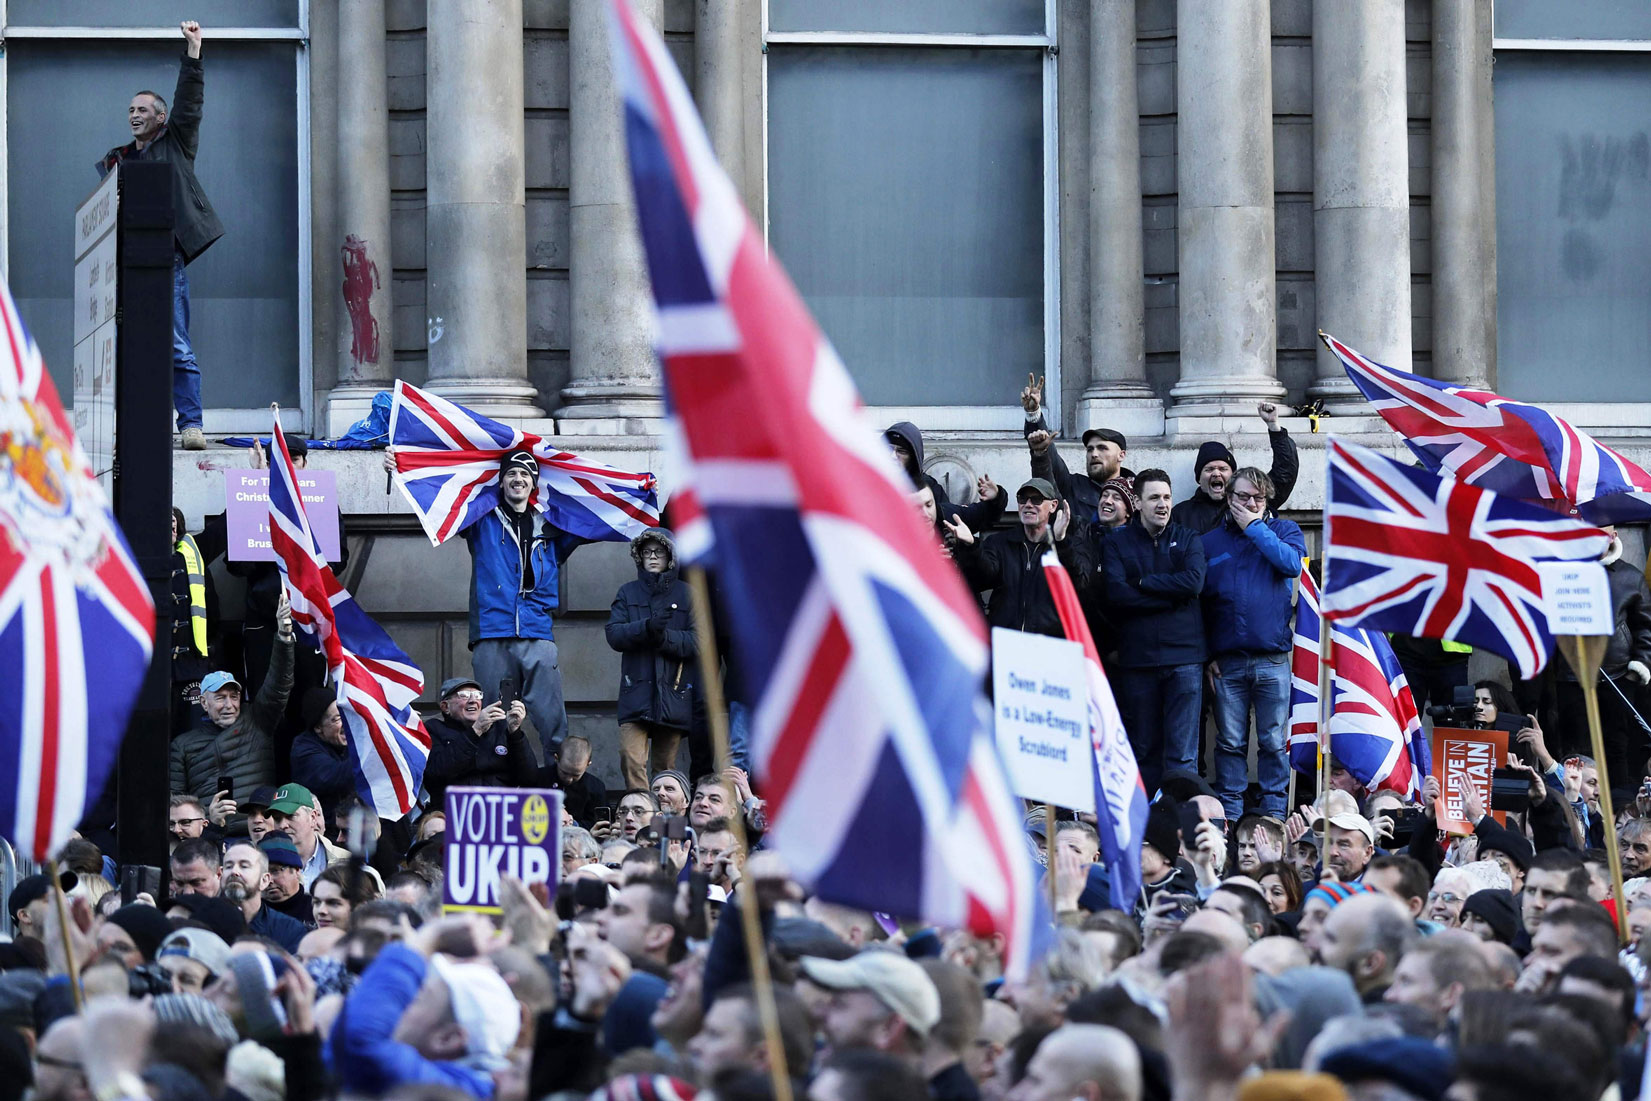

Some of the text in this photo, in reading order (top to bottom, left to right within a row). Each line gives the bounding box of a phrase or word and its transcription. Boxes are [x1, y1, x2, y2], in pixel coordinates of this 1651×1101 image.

[236, 492, 325, 503] Christ nner
[241, 476, 258, 486] For
[297, 480, 316, 488] ars
[248, 538, 272, 548] Brus
[1008, 671, 1070, 700] Owen Jones
[1002, 702, 1010, 718] is
[1023, 704, 1081, 740] Low-Energy
[1447, 741, 1466, 820] BELIEVE IN
[450, 794, 519, 843] VOTE
[449, 843, 550, 905] UKIP
